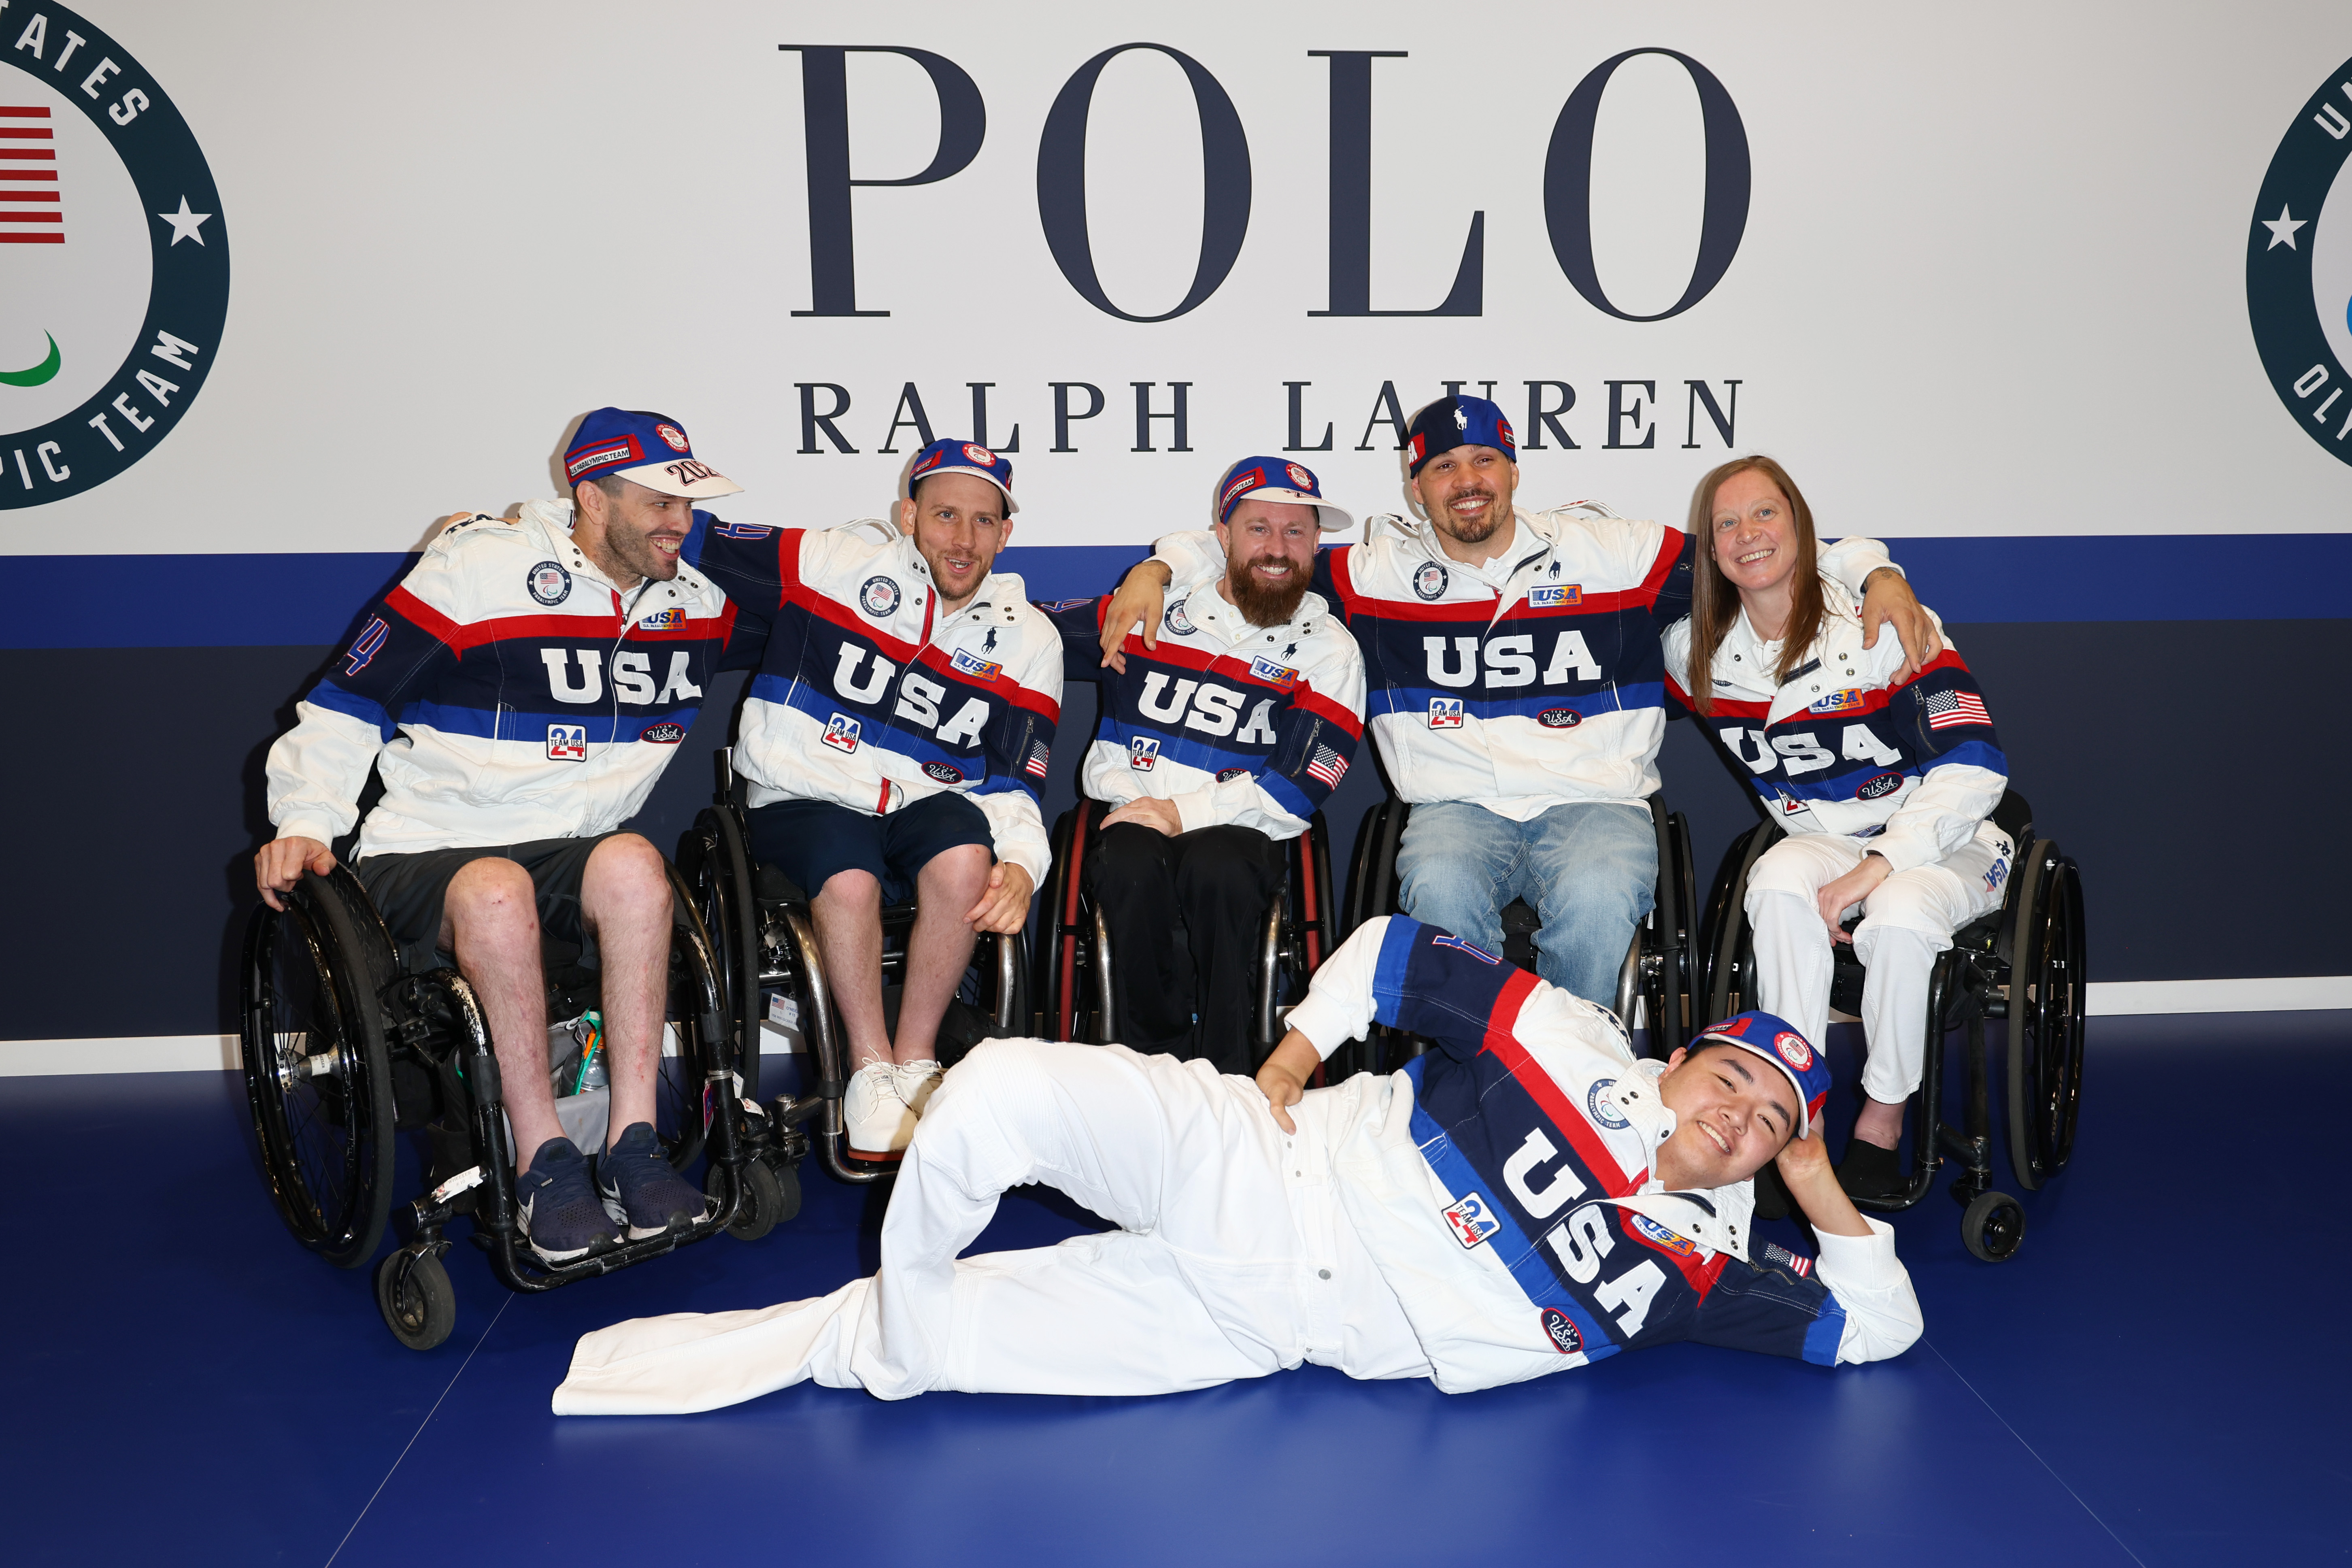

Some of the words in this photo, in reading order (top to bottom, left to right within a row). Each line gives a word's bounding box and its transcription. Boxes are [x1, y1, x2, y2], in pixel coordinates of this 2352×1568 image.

[0, 0, 149, 126] ATES
[2314, 82, 2352, 140] U
[778, 43, 1751, 323] POLO
[88, 330, 199, 452] TEAM
[794, 382, 1193, 454] RALPH
[1282, 380, 1742, 451] LAREN
[0, 441, 70, 490] IC
[577, 455, 608, 471] PARALYMPIC
[609, 449, 628, 459] TEAM
[1238, 479, 1254, 490] TEAM
[532, 563, 547, 574] UNITED
[548, 563, 565, 574] STATES
[1418, 563, 1431, 574] UNITED
[1431, 563, 1444, 571] STATES
[532, 592, 559, 604] PARALYMPIC
[559, 590, 569, 600] TEAM
[889, 581, 899, 595] STATES
[1417, 589, 1437, 599] PARALYMPIC
[1539, 588, 1577, 601] USA
[861, 596, 878, 615] PARALYMPIC
[648, 612, 683, 623] USA
[1166, 620, 1185, 634] PARALYMPIC
[961, 656, 997, 675] USA
[1423, 630, 1601, 689] USA
[540, 649, 702, 704] USA
[961, 666, 983, 675] PARALYMPIC
[1260, 662, 1294, 682] USA
[833, 641, 989, 749] USA
[1818, 691, 1858, 707] USA
[1138, 670, 1277, 745] USA
[1431, 701, 1461, 725] 24
[1543, 713, 1574, 725] USA
[551, 728, 584, 757] 24
[571, 739, 584, 748] USA
[647, 728, 680, 740] USA
[825, 717, 859, 749] 24
[829, 725, 845, 737] TEAM
[845, 731, 856, 741] USA
[1133, 739, 1157, 767] 24
[1144, 751, 1154, 759] USA
[1719, 723, 1902, 776] USA
[929, 765, 956, 781] USA
[1868, 776, 1885, 785] TEAM
[1862, 777, 1897, 797] USA
[1986, 858, 2008, 888] USA
[1777, 1041, 1793, 1065] PARALYMPIC
[1788, 1033, 1803, 1042] UNITED
[1803, 1042, 1812, 1057] STATES
[1589, 1092, 1604, 1123] PARALYMPIC
[448, 1171, 471, 1184] WHEELER
[1446, 1200, 1496, 1244] 24
[1456, 1204, 1474, 1224] TEAM
[1470, 1223, 1484, 1239] USA
[1503, 1127, 1667, 1338] USA
[1643, 1217, 1689, 1249] USA
[1643, 1228, 1671, 1245] PARALYMPIC
[1549, 1315, 1578, 1350] USA
[1564, 1320, 1578, 1337] TEAM
